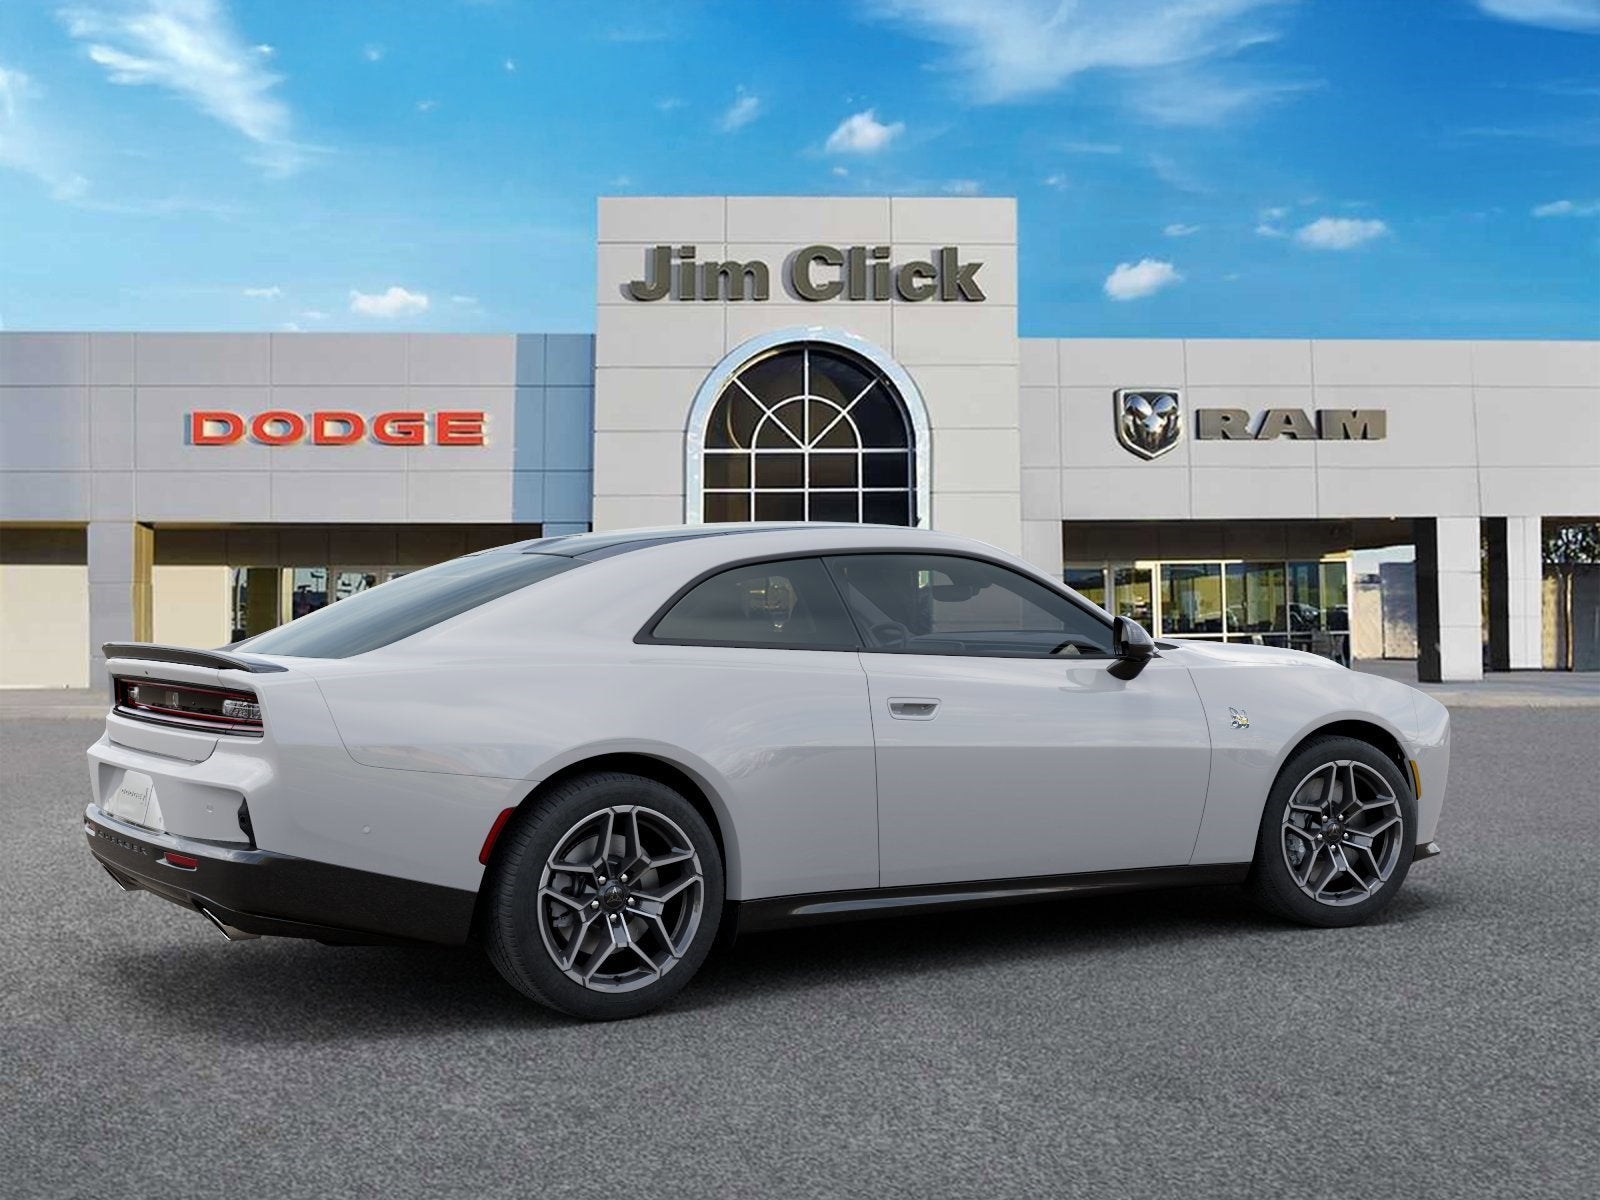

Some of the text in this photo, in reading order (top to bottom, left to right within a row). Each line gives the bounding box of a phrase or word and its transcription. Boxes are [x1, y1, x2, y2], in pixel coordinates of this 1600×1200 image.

[626, 245, 986, 302] Jim Click
[189, 410, 486, 447] DODGE
[1195, 408, 1387, 441] RAM
